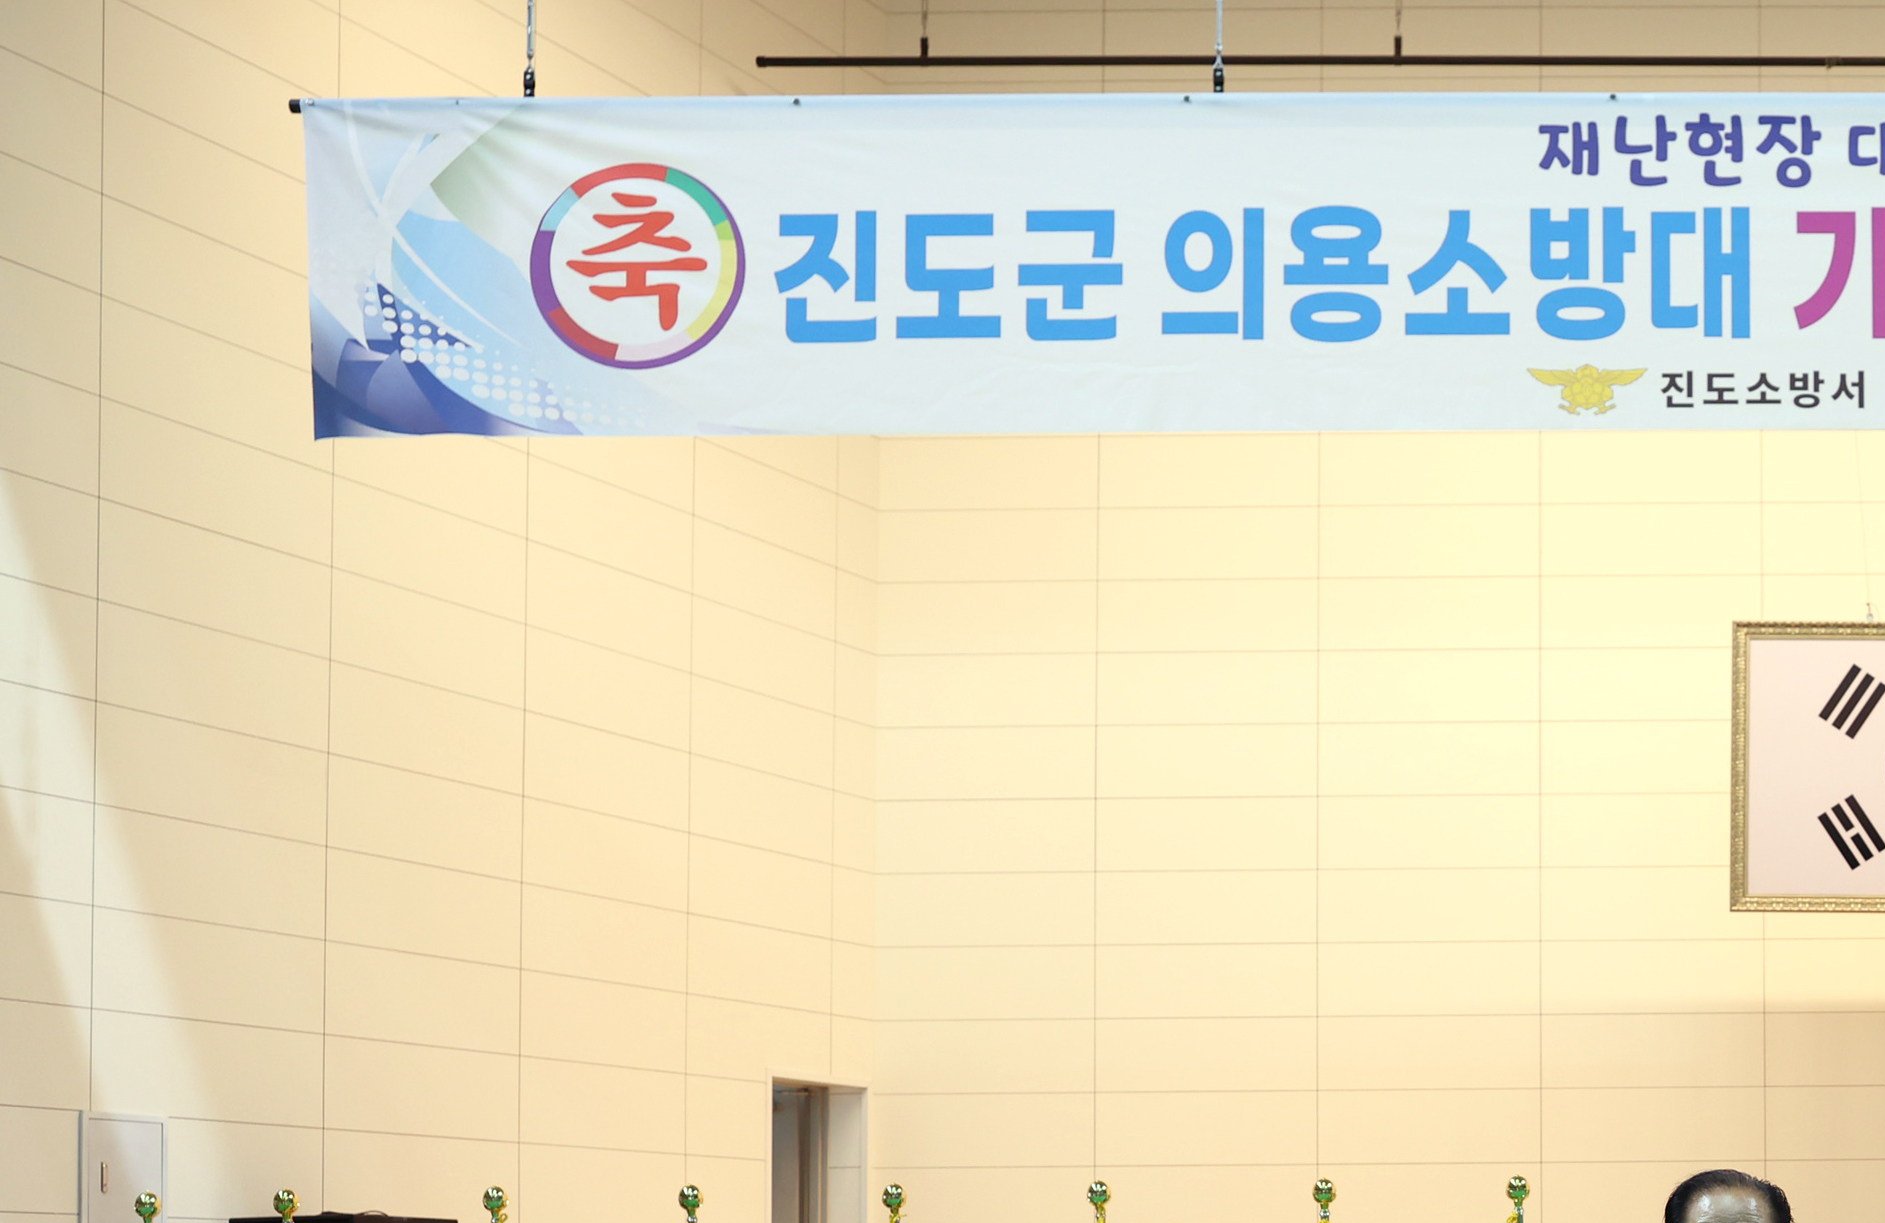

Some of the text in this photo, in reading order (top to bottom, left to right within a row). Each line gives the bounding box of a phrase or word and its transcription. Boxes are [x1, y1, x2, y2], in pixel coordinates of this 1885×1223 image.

[1538, 113, 1822, 188] 재난현장
[566, 192, 708, 331] 축
[774, 210, 1123, 343] 진도군
[1162, 206, 1750, 342] 의용소방대
[1661, 371, 1865, 408] 진도소방서
